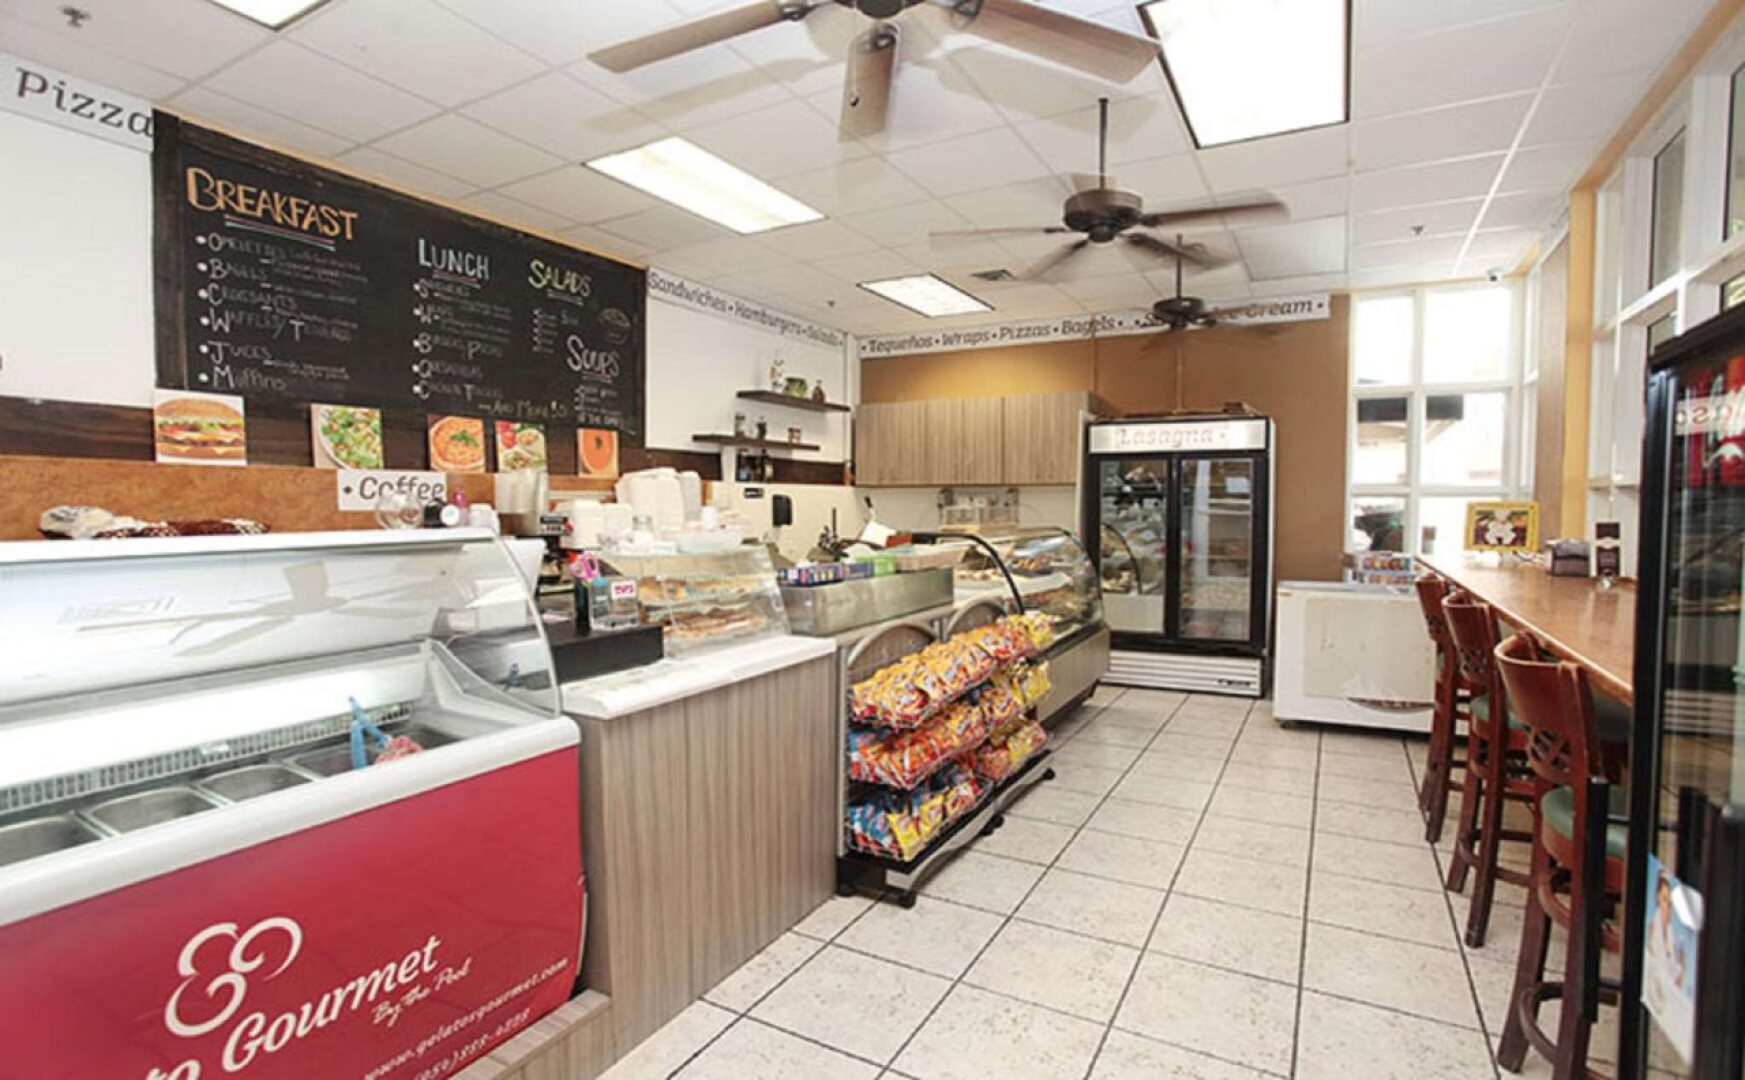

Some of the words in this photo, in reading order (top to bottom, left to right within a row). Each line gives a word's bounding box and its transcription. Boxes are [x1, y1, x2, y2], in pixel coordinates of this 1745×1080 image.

[15, 66, 154, 139] Pizza
[186, 167, 358, 240] BREAKFAST
[418, 238, 489, 280] LUNCH
[528, 259, 592, 297] SALADS
[648, 272, 727, 313] Sandwiches
[734, 301, 802, 336] Hamburgers
[1248, 299, 1314, 317] Cream
[868, 335, 933, 354] Tequeños
[942, 329, 991, 347] Wraps
[999, 323, 1051, 340] Pizzas
[1061, 314, 1115, 336] Bagels
[1119, 427, 1213, 448] Lasagna
[359, 476, 445, 501] Coffee
[222, 934, 441, 1074] Gourmet
[372, 1000, 402, 1027] By
